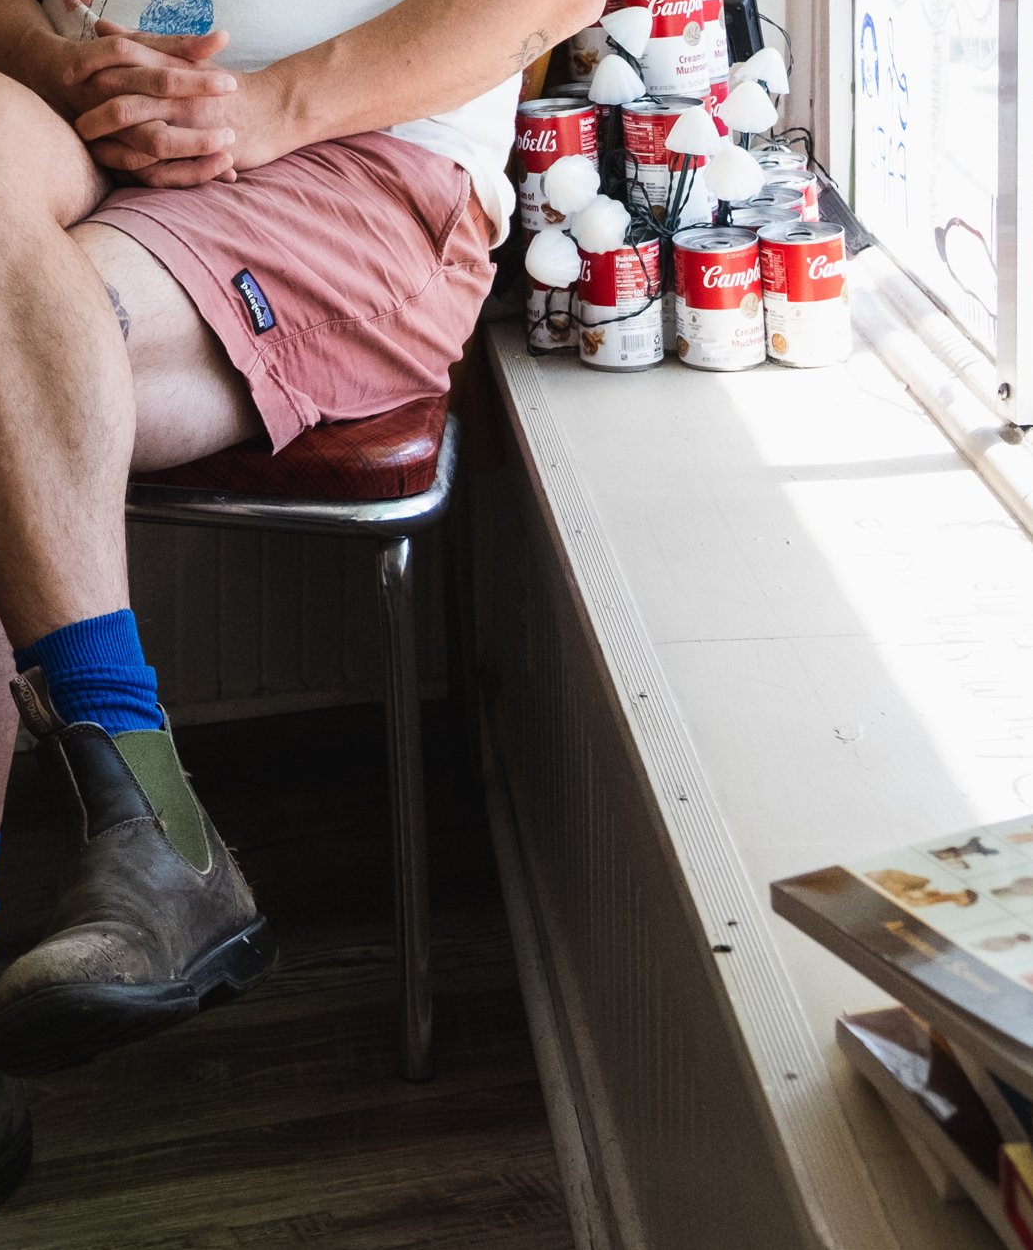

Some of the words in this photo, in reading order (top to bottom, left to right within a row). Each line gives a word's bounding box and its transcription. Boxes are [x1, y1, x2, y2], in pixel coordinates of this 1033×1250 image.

[678, 53, 701, 65] Cream
[615, 261, 632, 269] Facts
[633, 289, 645, 297] 100
[240, 282, 266, 328] patagonia
